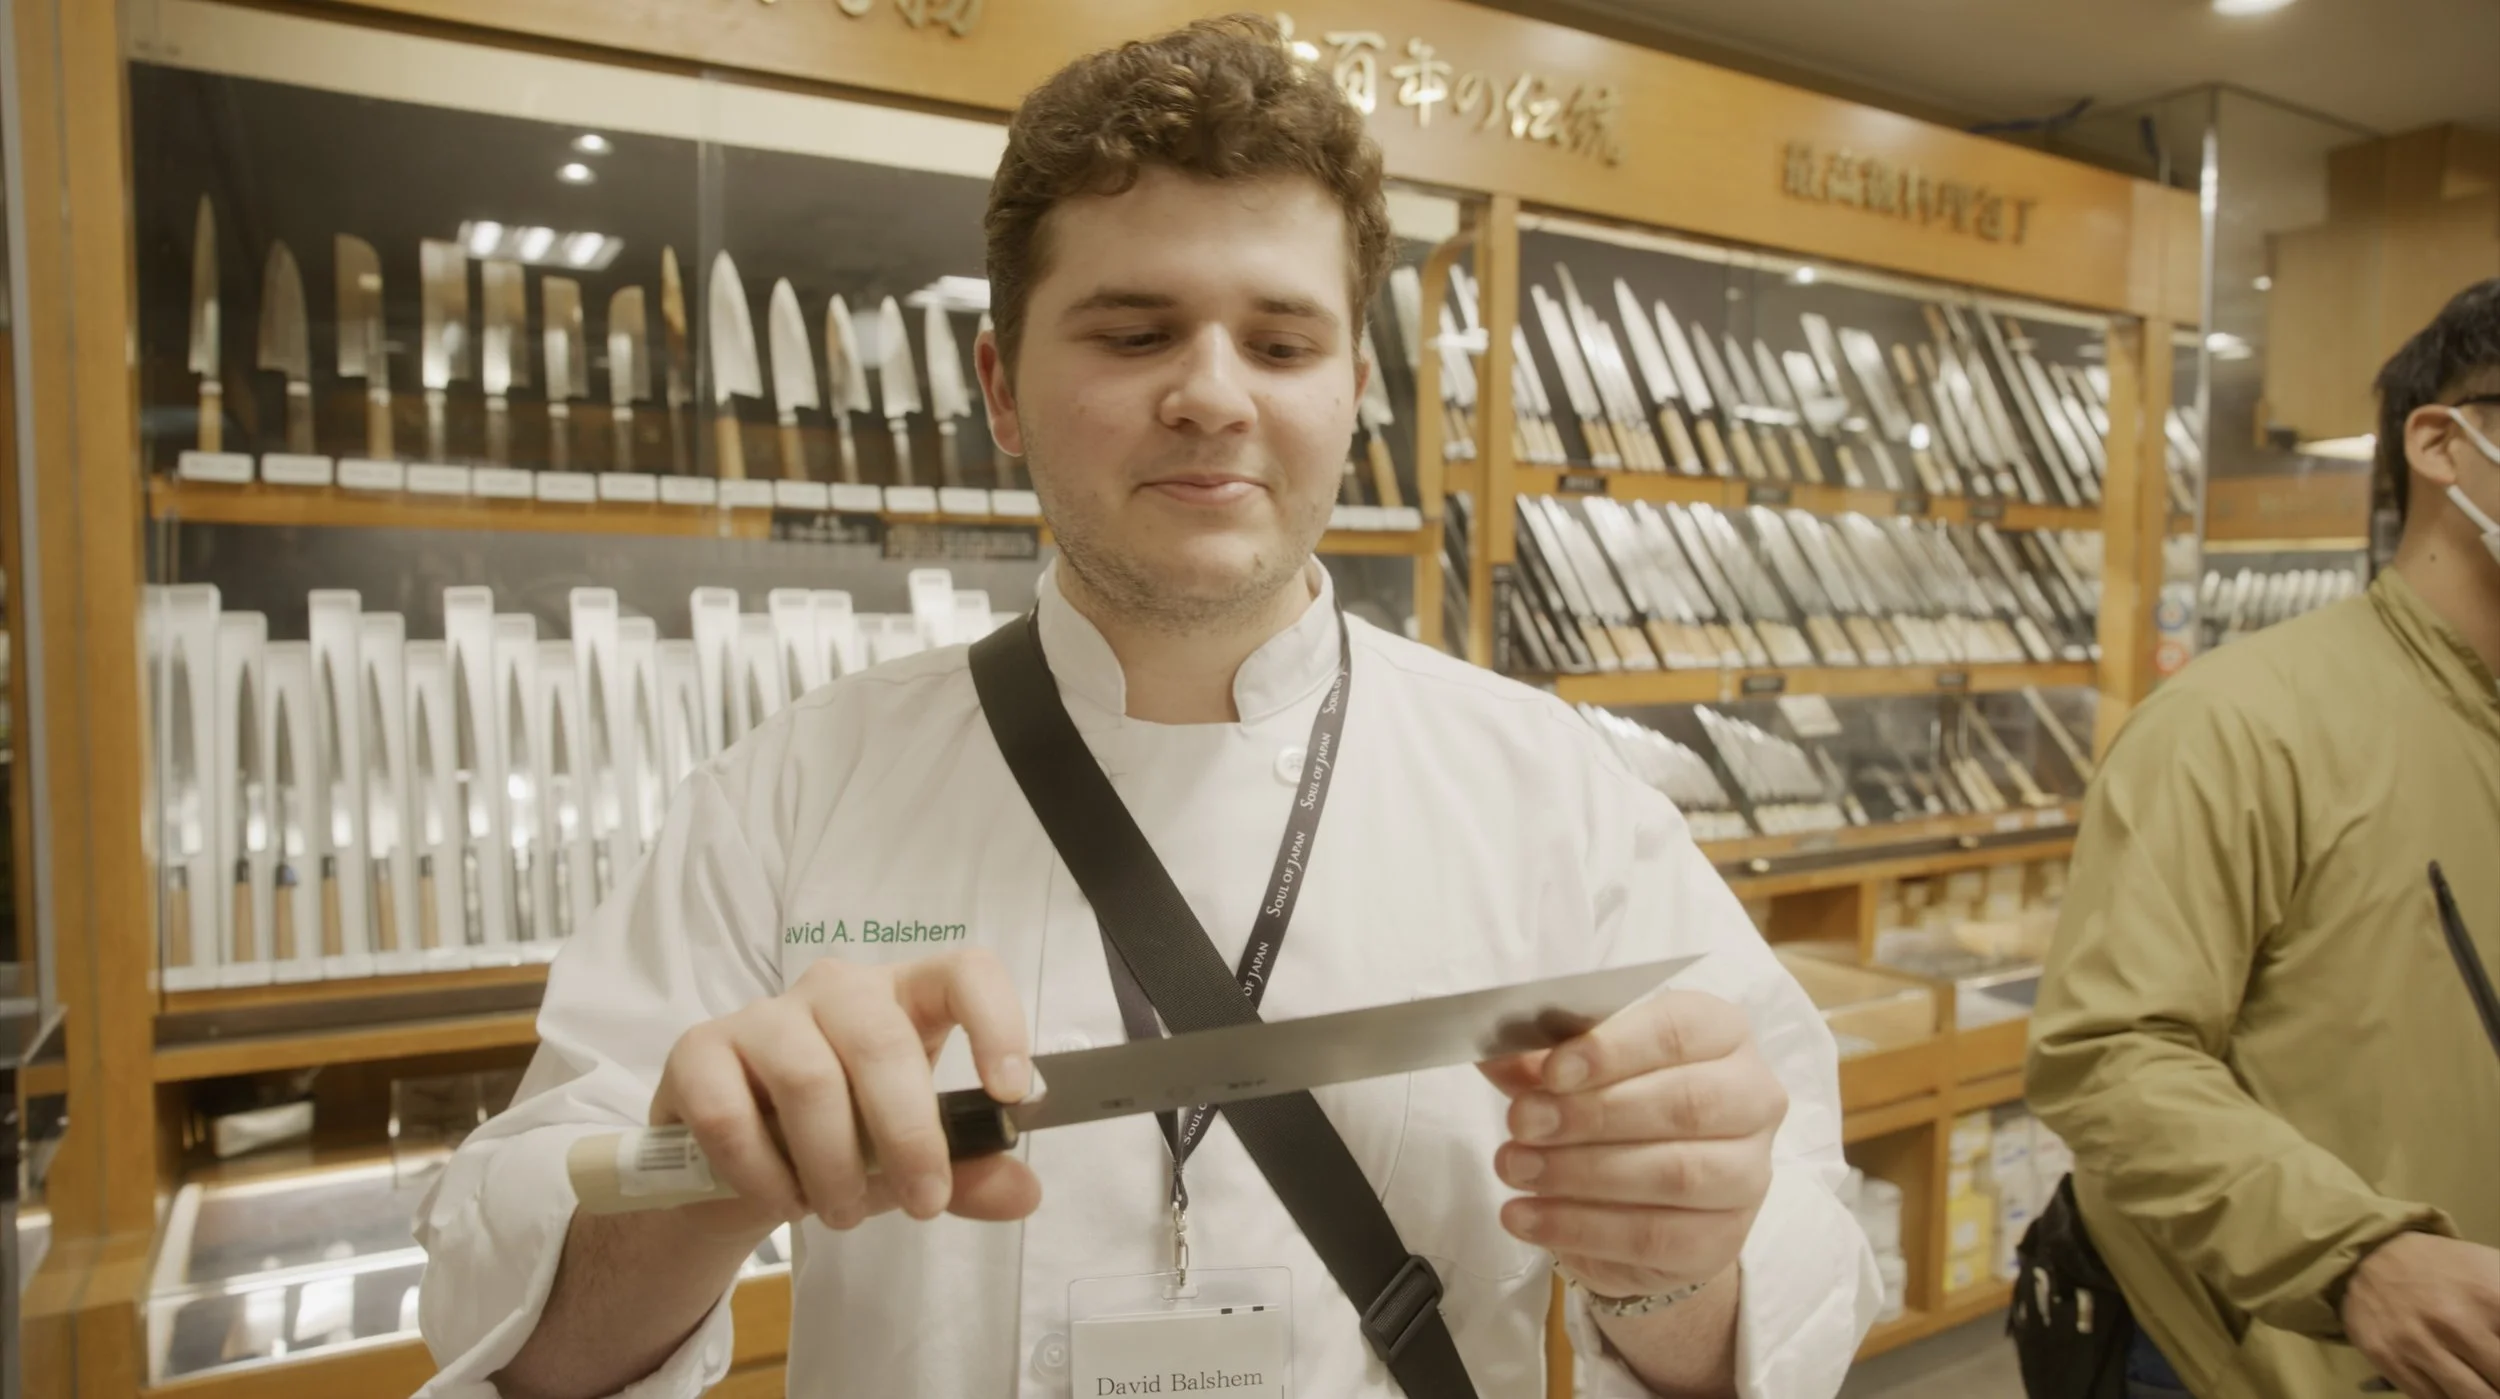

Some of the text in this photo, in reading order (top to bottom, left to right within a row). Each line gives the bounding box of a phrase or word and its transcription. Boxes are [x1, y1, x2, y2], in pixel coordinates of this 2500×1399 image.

[1300, 732, 1332, 811] SOUL OF JAPAN
[1266, 830, 1306, 918] SOUL OF JAPAN
[784, 919, 967, 944] avid A. Balshem
[1243, 941, 1270, 997] OF JAPAN
[1183, 1112, 1204, 1146] SOUL
[1096, 1369, 1264, 1397] David Balshem
